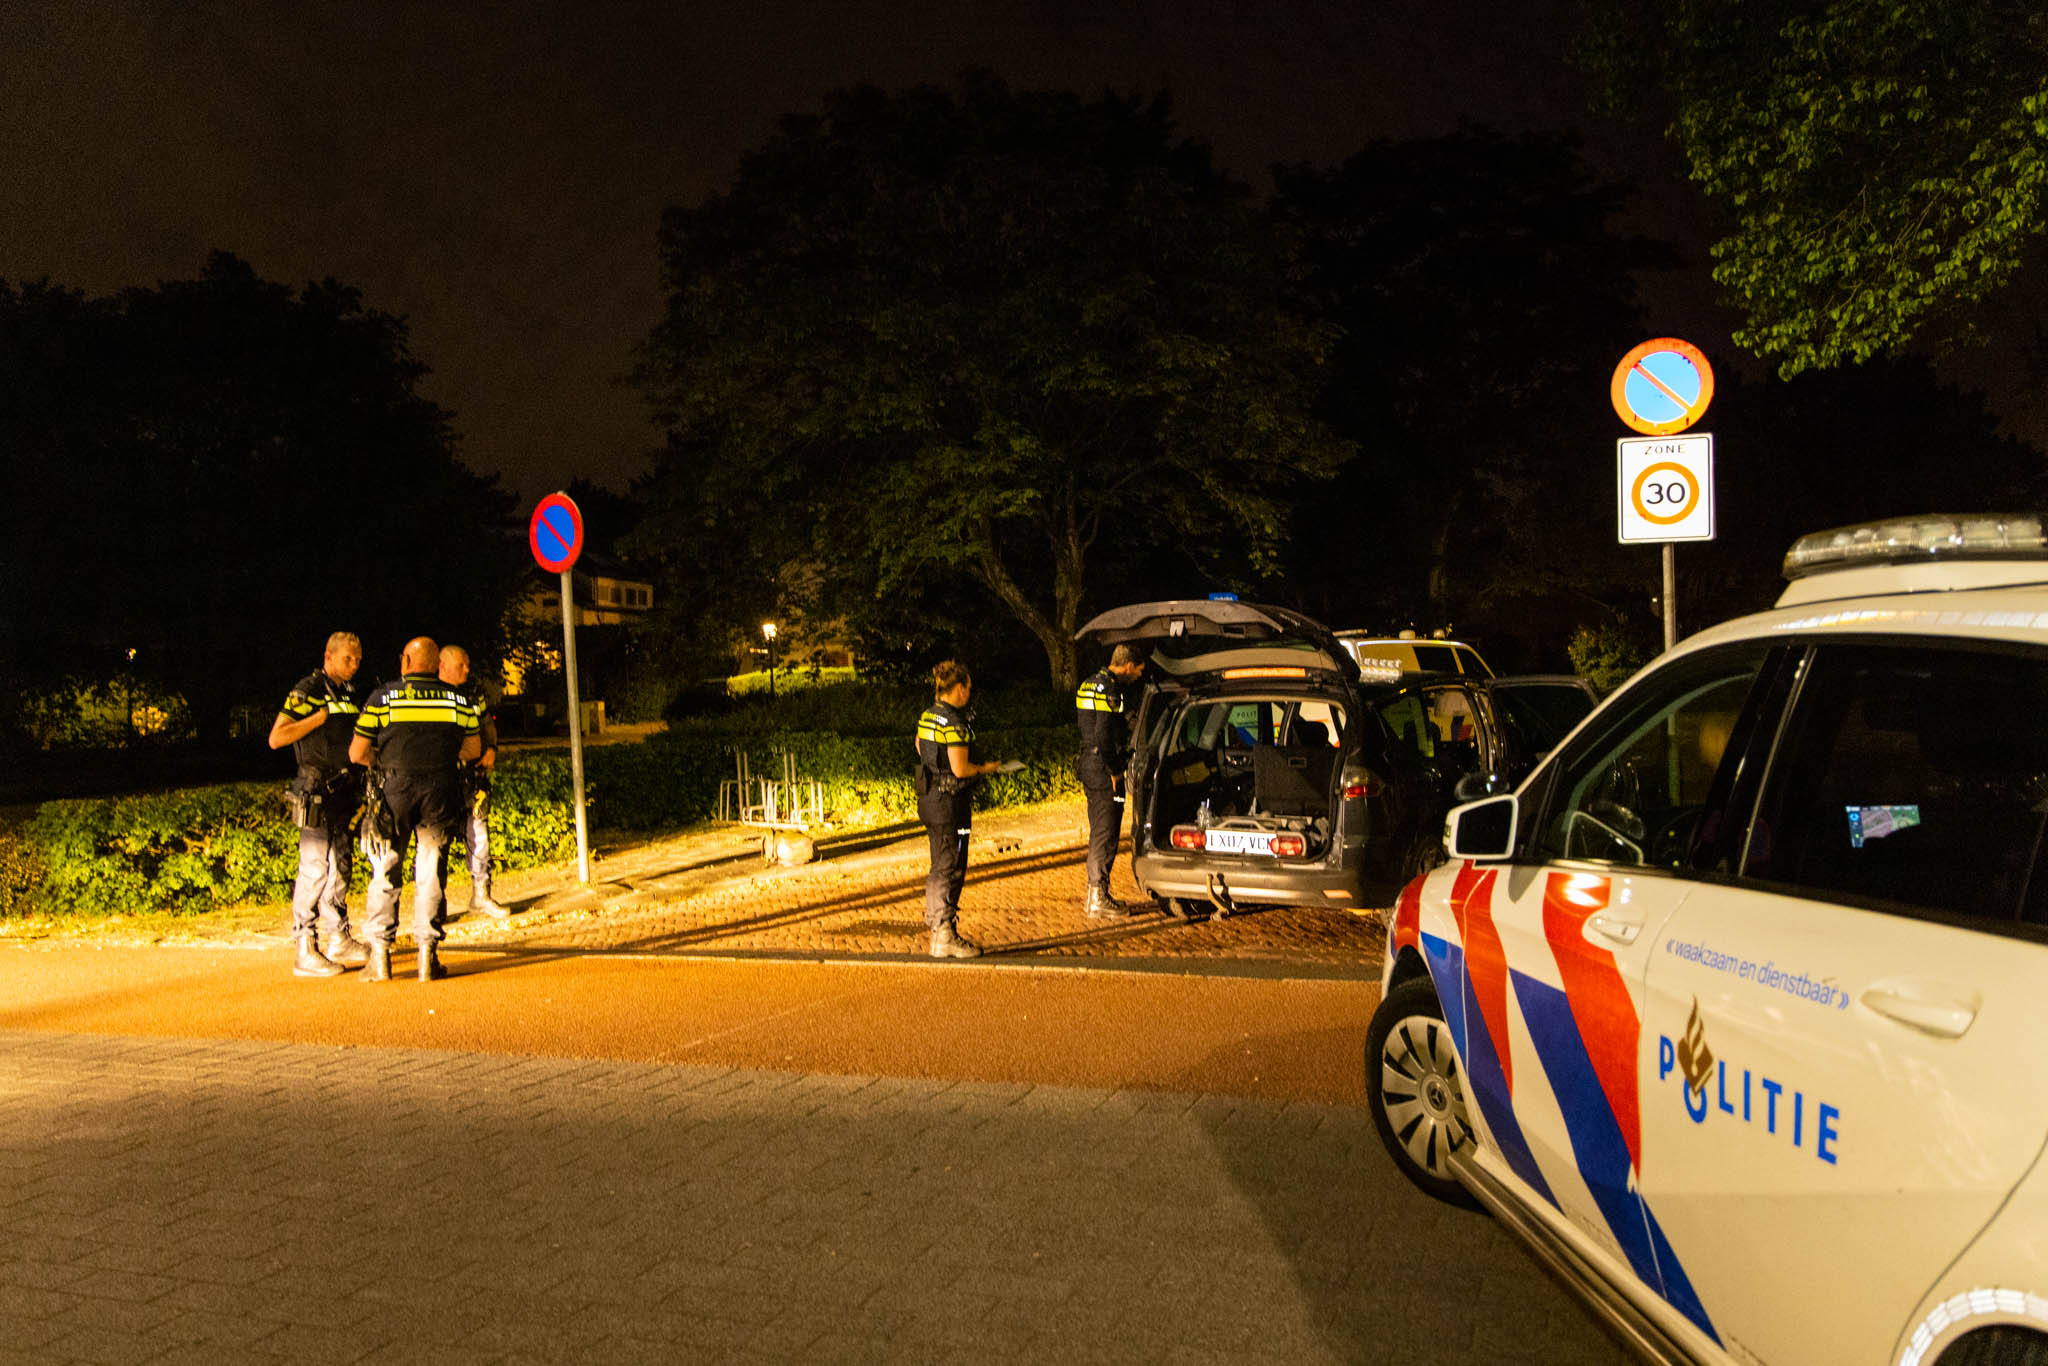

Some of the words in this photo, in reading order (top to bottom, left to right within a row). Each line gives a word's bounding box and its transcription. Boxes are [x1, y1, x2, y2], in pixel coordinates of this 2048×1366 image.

[1644, 443, 1687, 456] ZONE
[1646, 482, 1686, 505] 30
[1738, 959, 1757, 981] en
[1659, 1033, 1840, 1166] POLITIE
